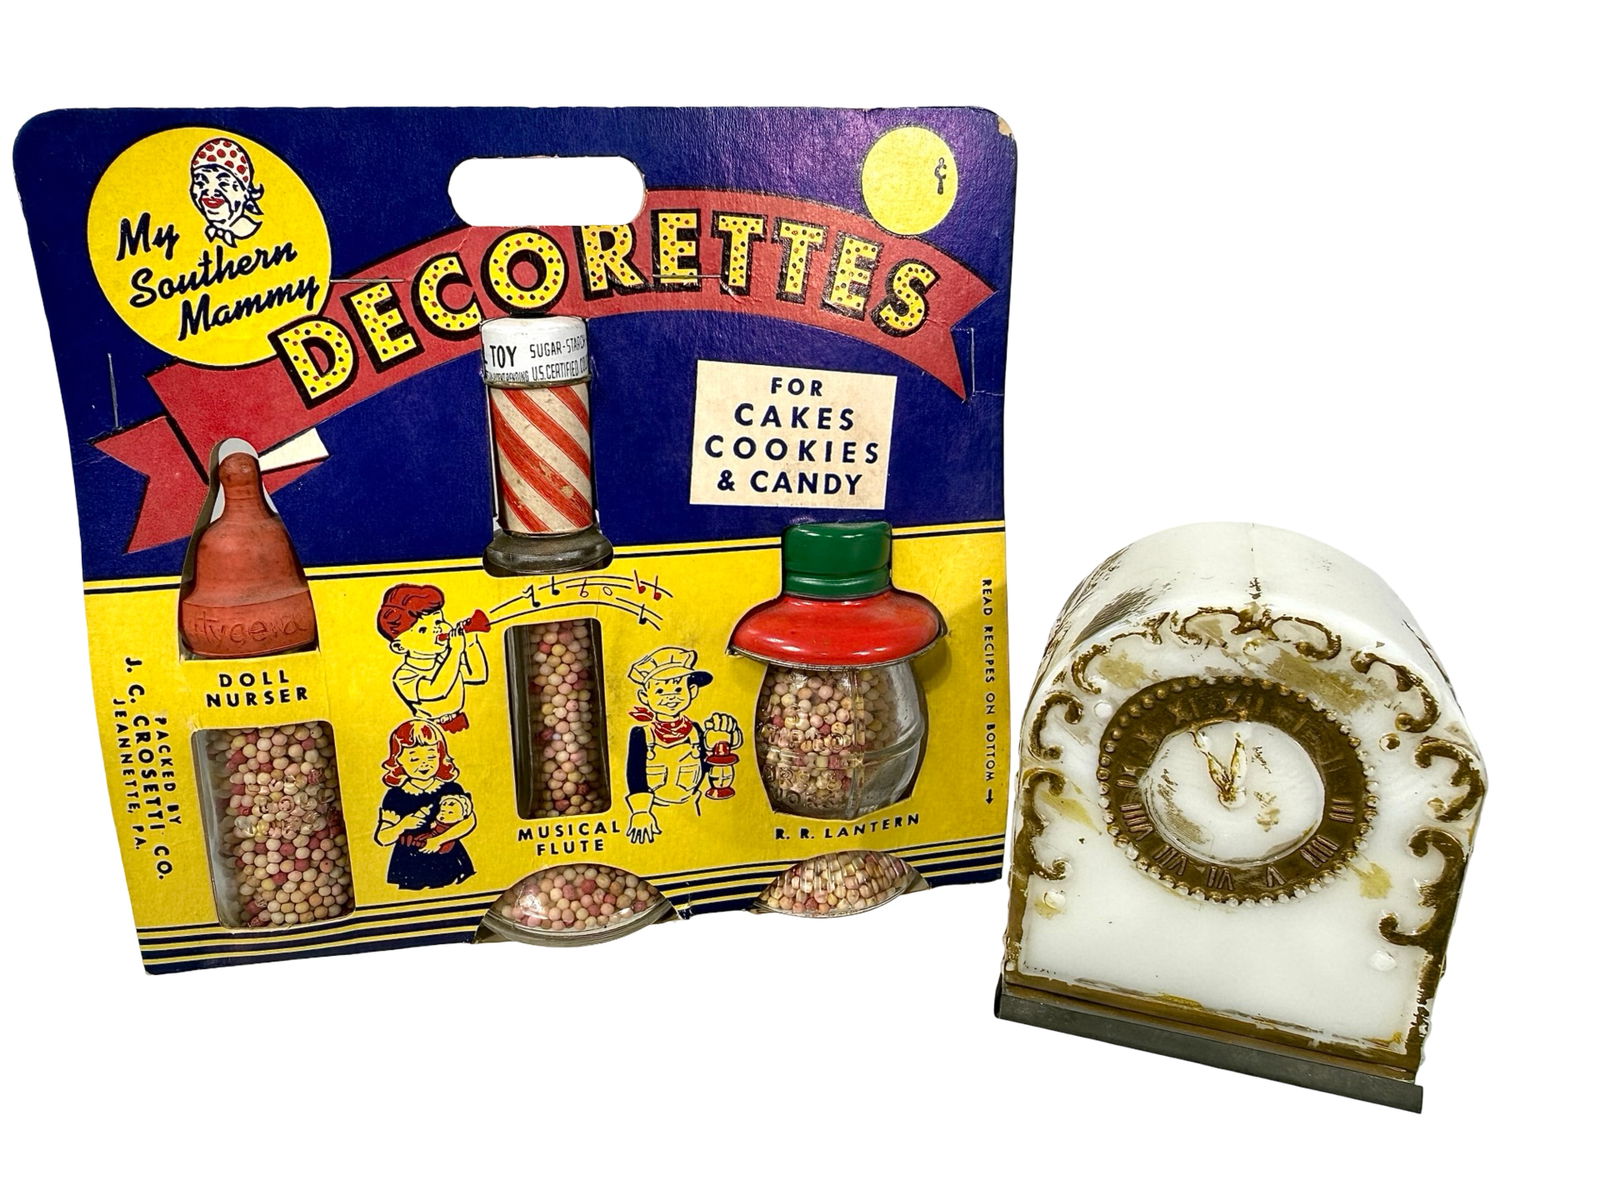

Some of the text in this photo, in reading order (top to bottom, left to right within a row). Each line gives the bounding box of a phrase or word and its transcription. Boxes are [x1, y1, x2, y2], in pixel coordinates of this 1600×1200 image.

[116, 212, 180, 261] My
[129, 243, 298, 308] Southern
[177, 275, 320, 342] Mammy
[270, 208, 942, 409] DECORETTES
[489, 345, 517, 368] TOY
[771, 377, 823, 396] FOR
[734, 403, 854, 430] CAKES
[705, 435, 879, 464] COOKIES
[717, 469, 862, 495] & CANDY
[218, 669, 289, 688] DOLL
[982, 579, 996, 781] READ RECIPES ON BOTTOM
[206, 687, 308, 707] NURSER
[113, 699, 147, 850] JEANNETTE, PA.
[125, 657, 173, 880] J. C. CROSETTI CO.
[154, 717, 182, 825] PACKED BY
[517, 820, 620, 842] MUSICAL
[776, 813, 920, 841] R. R. LANTERN
[537, 838, 604, 856] FLUTE
